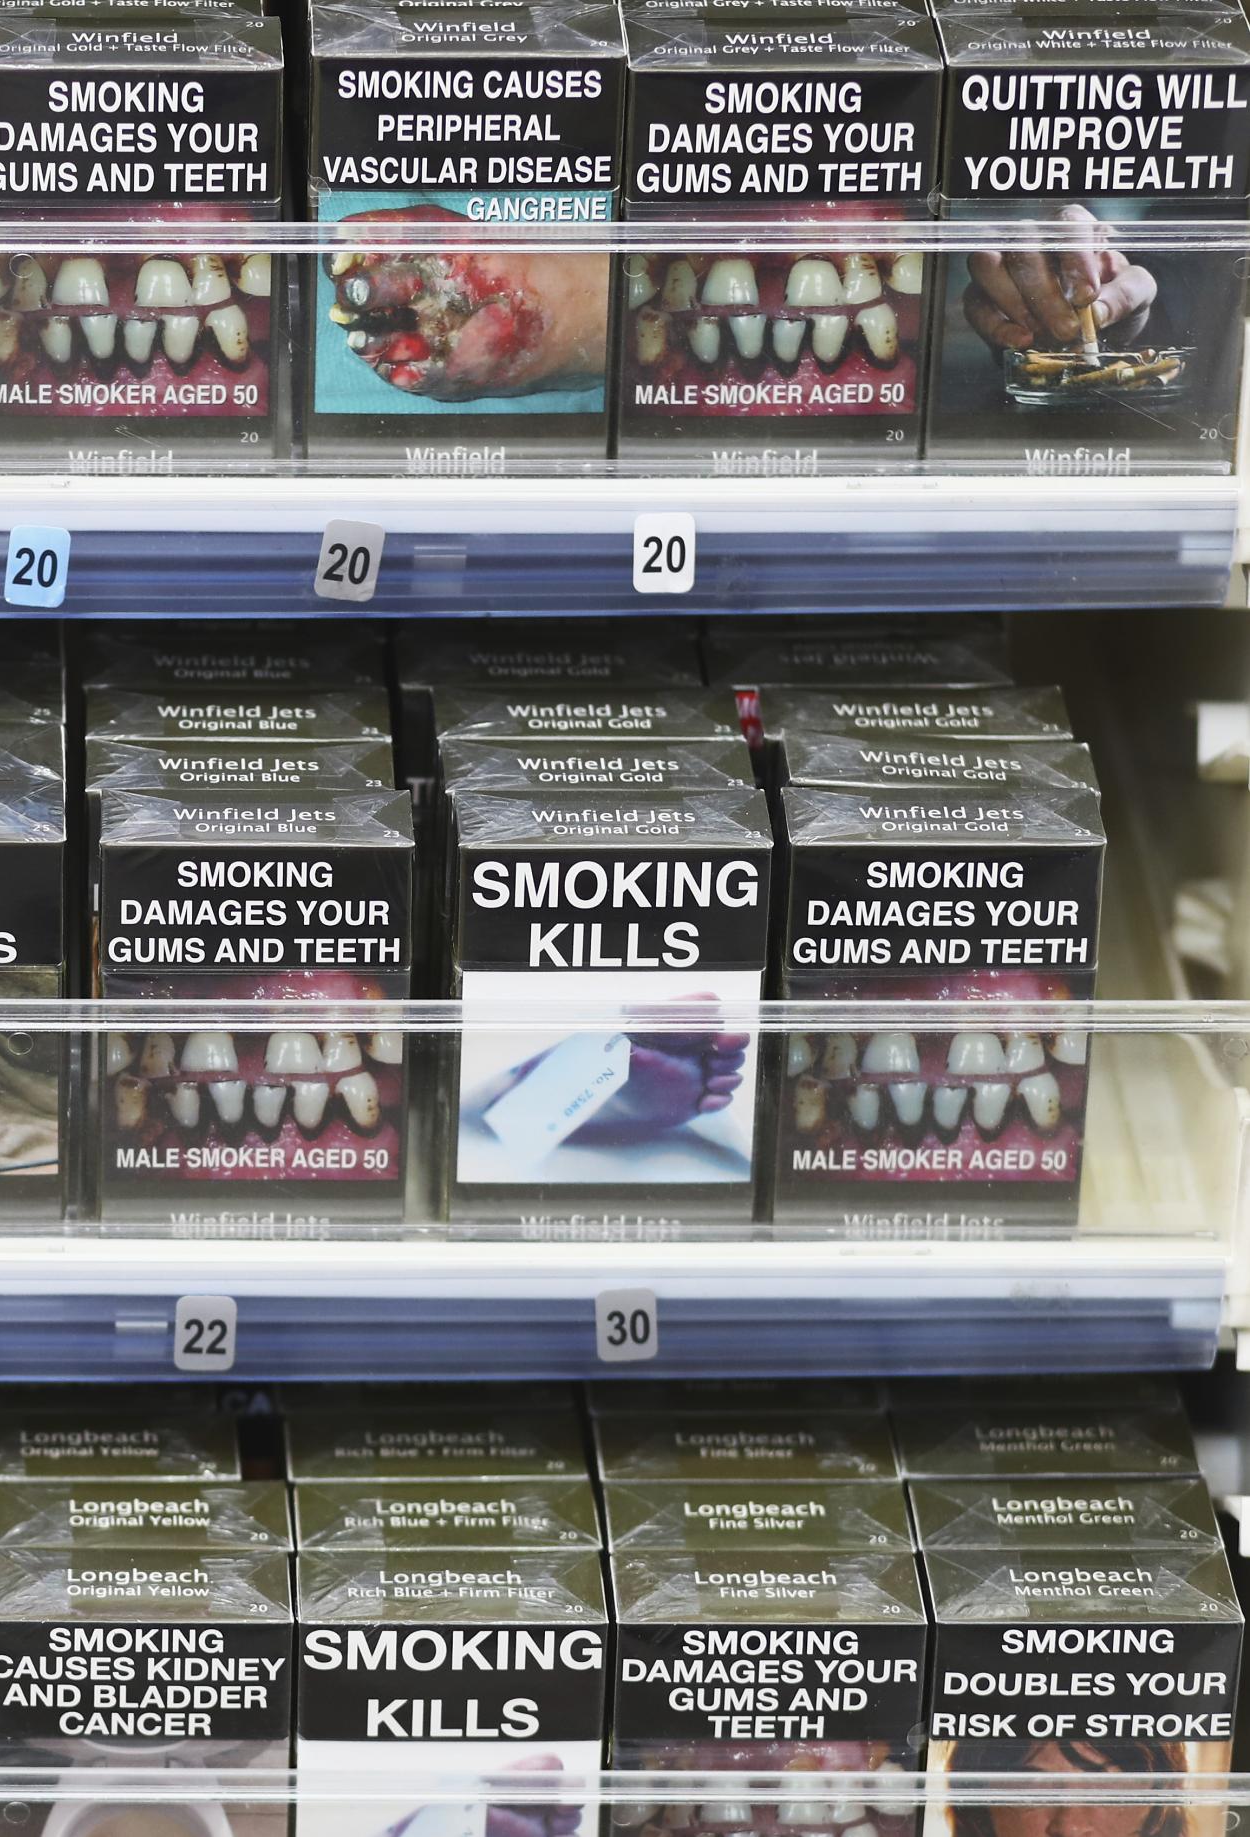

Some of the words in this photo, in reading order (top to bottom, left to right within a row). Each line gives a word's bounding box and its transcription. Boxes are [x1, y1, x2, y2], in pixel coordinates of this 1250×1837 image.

[414, 22, 515, 31] Winfield
[398, 32, 475, 43] Original
[484, 34, 527, 43] Grey
[726, 33, 832, 44] Winfield
[339, 71, 473, 98] SMOKING
[484, 70, 601, 98] CAUSES
[962, 74, 1141, 111] QUITTING
[1157, 74, 1247, 109] WILL
[378, 115, 560, 141] PERIPHERAL
[1010, 116, 1183, 150] IMPROVE
[323, 156, 477, 183] VASCULAR
[488, 156, 611, 183] DISEASE
[965, 157, 1070, 190] YOUR
[1085, 155, 1233, 189] HEALTH
[466, 197, 606, 221] GANGRENE
[56, 383, 156, 406] SMOKER
[163, 385, 226, 404] AGED
[233, 385, 257, 408] 50
[886, 430, 904, 442] 20
[323, 543, 370, 584] 20
[643, 536, 685, 573] 20
[13, 548, 57, 587] 20
[173, 808, 278, 820] Winfield
[287, 809, 335, 822] Jets
[532, 810, 638, 822] Winfield
[646, 809, 695, 823] Jets
[859, 806, 966, 818] Winfield
[975, 808, 1023, 820] Jets
[196, 823, 269, 834] Original
[278, 823, 316, 832] Blue
[384, 830, 400, 838] 23
[554, 825, 627, 836] Original
[636, 825, 679, 834] Gold
[882, 822, 957, 833] Original
[965, 822, 1008, 831] Gold
[1075, 827, 1091, 836] 23
[178, 861, 332, 887] SMOKING
[473, 861, 758, 908] SMOKING
[121, 900, 286, 925] DAMAGES
[297, 900, 389, 926] YOUR
[109, 937, 205, 963] GUMS
[214, 939, 284, 962] AND
[294, 938, 399, 962] TEETH
[530, 922, 699, 967] KILLS
[183, 1319, 227, 1355] 22
[607, 1310, 650, 1346] 30
[70, 1499, 209, 1516] Longbeach
[992, 1497, 1133, 1515] Longbeach
[69, 1515, 143, 1529] Original
[150, 1515, 210, 1527] Yellow
[997, 1513, 1073, 1524] Menthol
[1080, 1513, 1135, 1524] Green
[67, 1568, 208, 1586] Longbeach
[695, 1570, 837, 1591] Longbeach
[1010, 1568, 1152, 1588] Longbeach
[65, 1585, 140, 1598] Original
[148, 1585, 211, 1596] Yellow
[720, 1587, 761, 1598] Fine
[765, 1587, 816, 1598] Silver
[1015, 1585, 1091, 1597] Menthol
[1098, 1585, 1154, 1596] Green
[250, 1604, 267, 1612] 20
[883, 1605, 900, 1613] 20
[1200, 1603, 1218, 1611] 20
